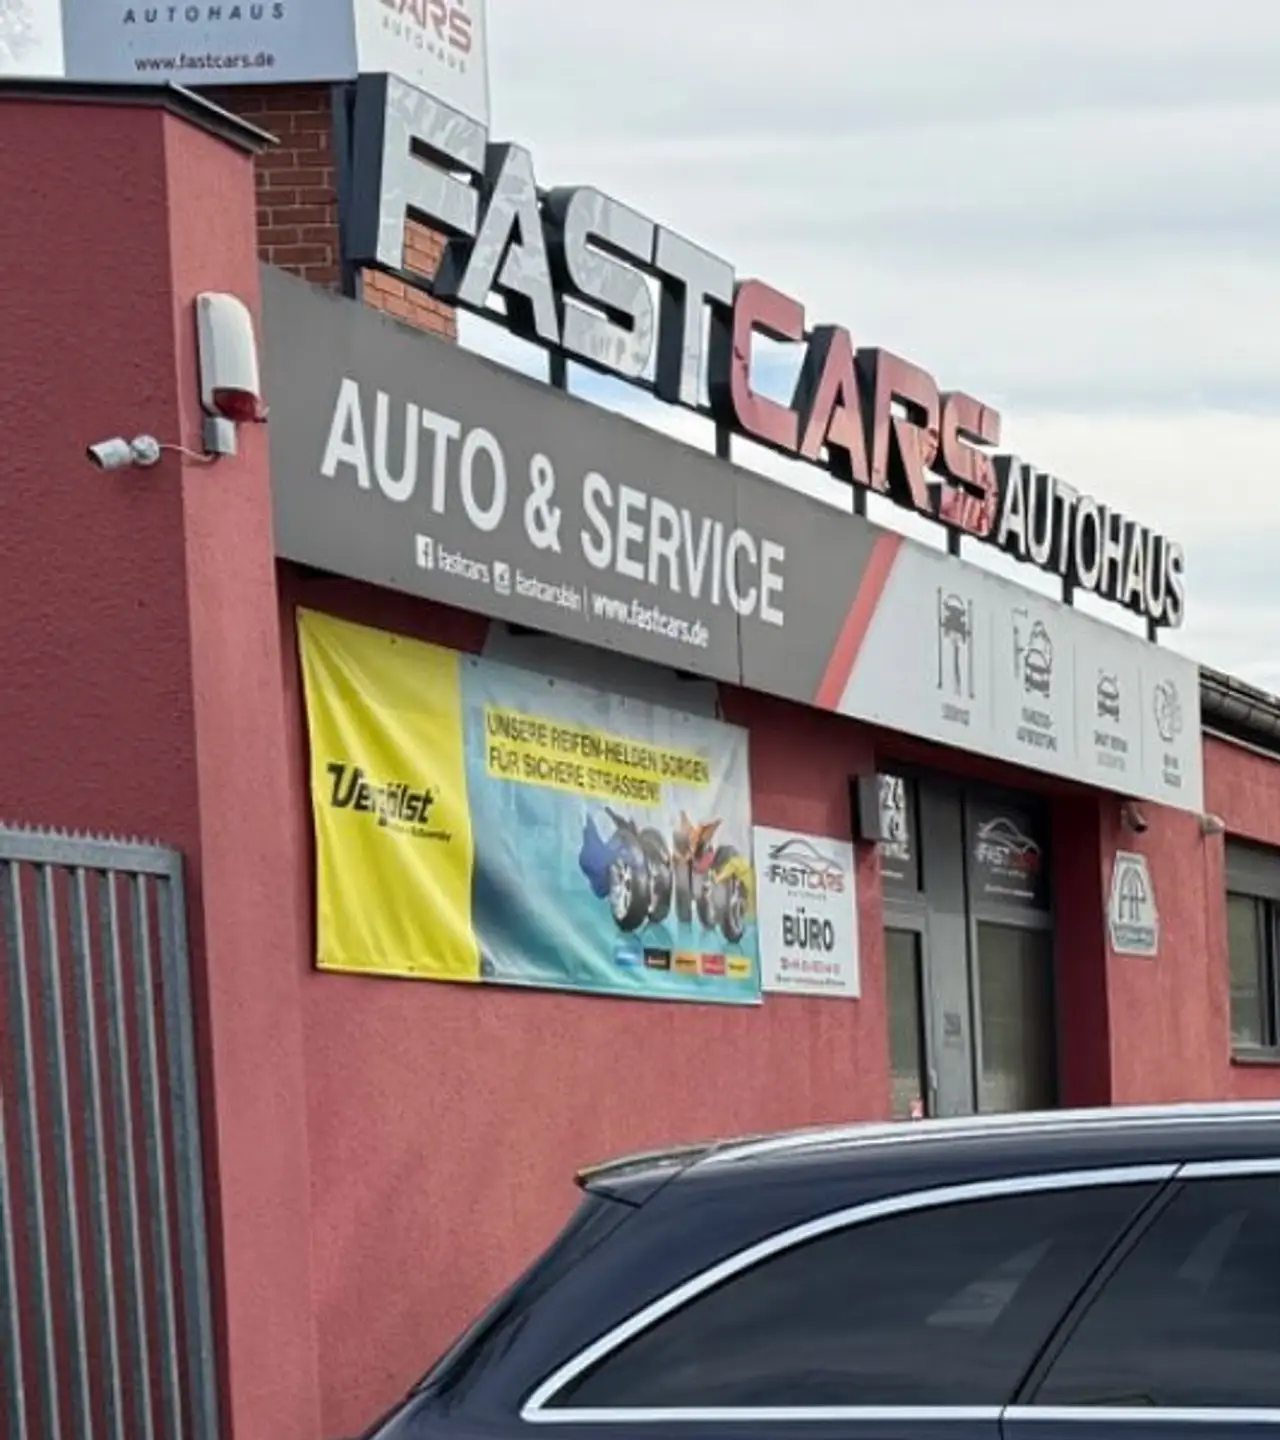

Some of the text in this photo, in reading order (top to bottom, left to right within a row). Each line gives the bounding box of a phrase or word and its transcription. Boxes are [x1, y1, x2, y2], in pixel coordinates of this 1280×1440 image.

[122, 2, 286, 24] AUTOHAUS
[134, 52, 275, 72] www.fastcars.de
[320, 377, 786, 626] AUTO & SERVICE
[997, 454, 1186, 630] AUTOHAUS
[592, 592, 709, 648] www.fastcars.de
[488, 709, 548, 748] UNSERE
[489, 740, 520, 776] FÜR
[522, 752, 586, 789] SICHERE
[782, 906, 835, 952] BÜRO
